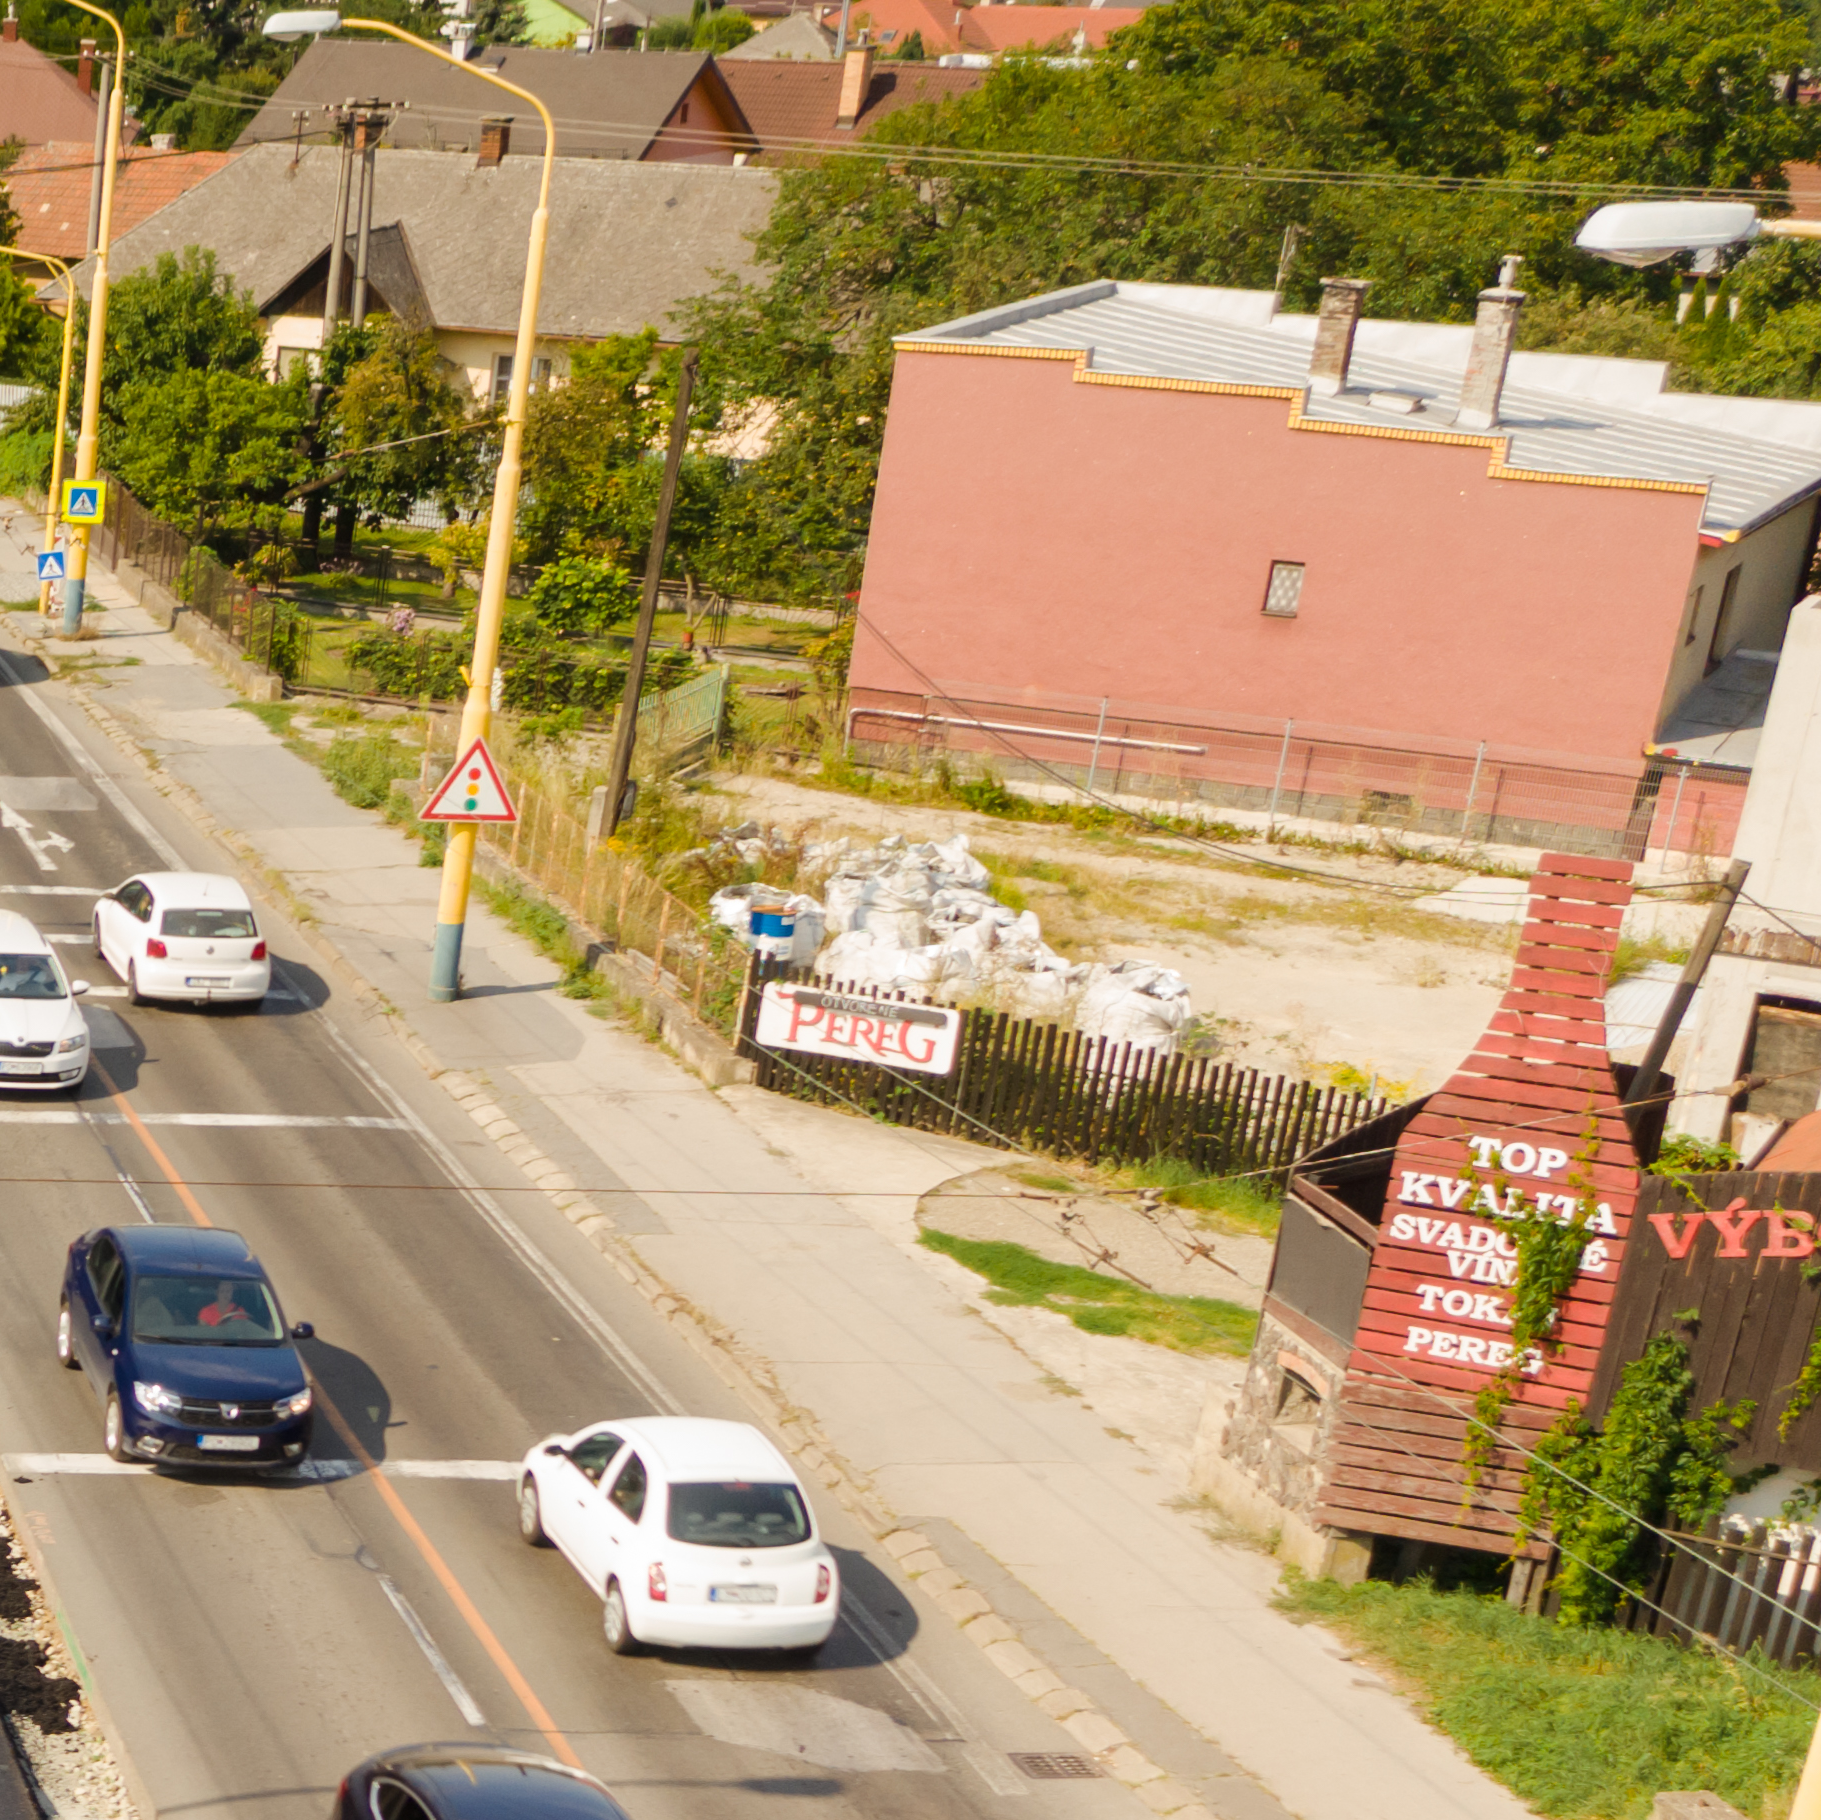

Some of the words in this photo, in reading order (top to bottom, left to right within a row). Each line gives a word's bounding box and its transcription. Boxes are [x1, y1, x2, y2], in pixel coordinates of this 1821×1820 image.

[776, 991, 936, 1063] PEREG
[1468, 1135, 1568, 1178] TOP
[1397, 1171, 1618, 1235] KVALITA
[1403, 1325, 1545, 1376] PEREG
